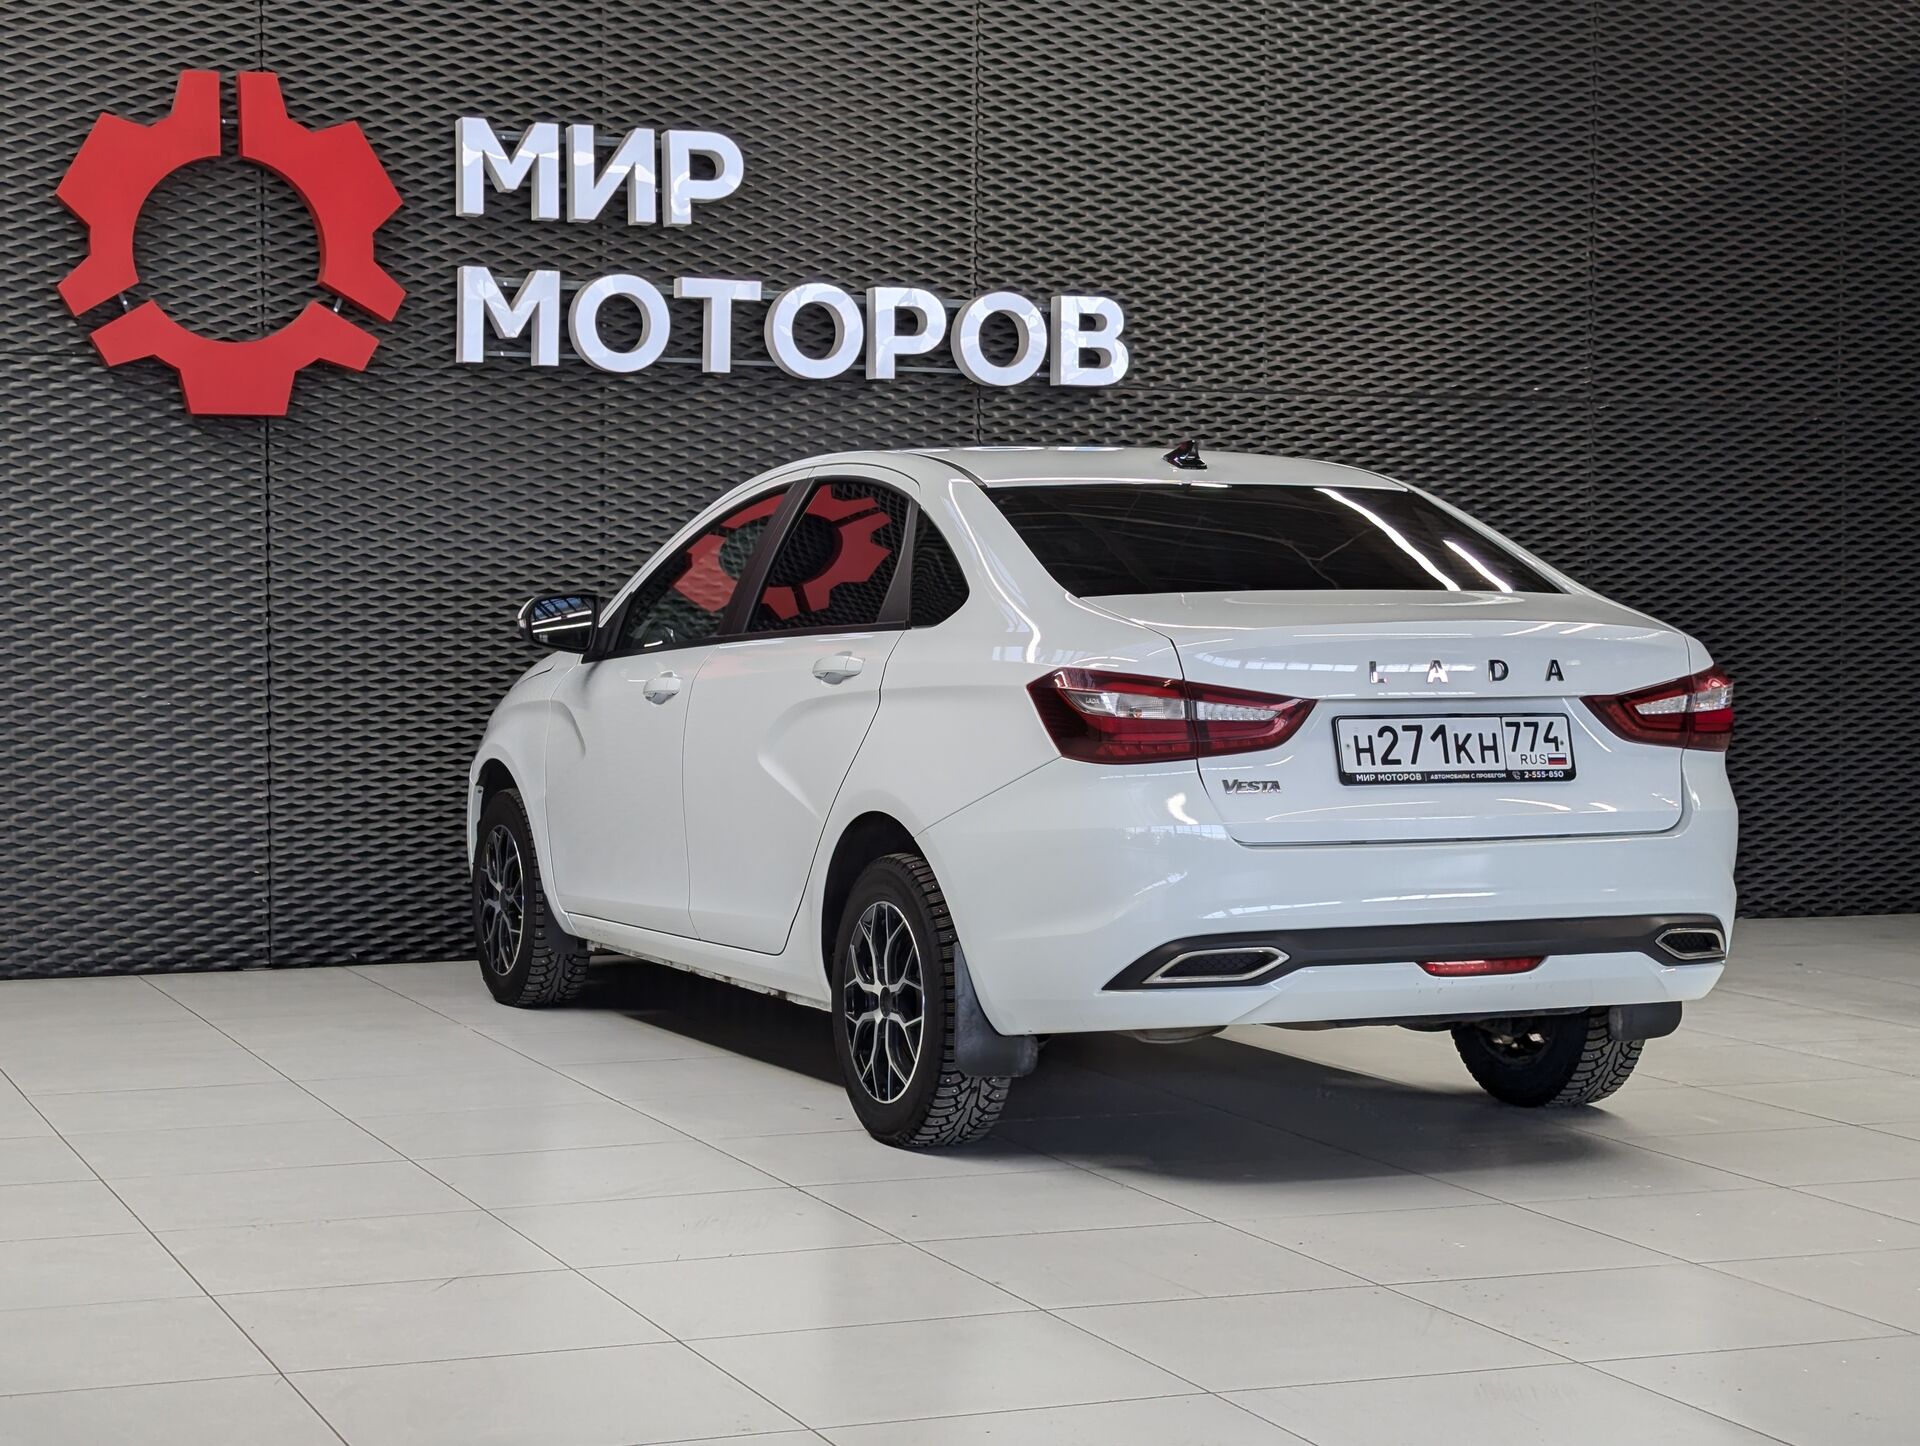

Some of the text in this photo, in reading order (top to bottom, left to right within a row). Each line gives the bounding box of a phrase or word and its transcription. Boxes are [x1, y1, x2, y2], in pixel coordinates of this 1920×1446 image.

[455, 117, 745, 227] МИР
[456, 265, 1130, 387] МОТОРОВ
[1369, 659, 1565, 684] LADA
[1353, 724, 1500, 766] Н271КН
[1505, 721, 1560, 752] 774
[1520, 753, 1547, 765] RUS
[1356, 773, 1376, 782] МИР
[1378, 772, 1422, 781] МОТОРОВ
